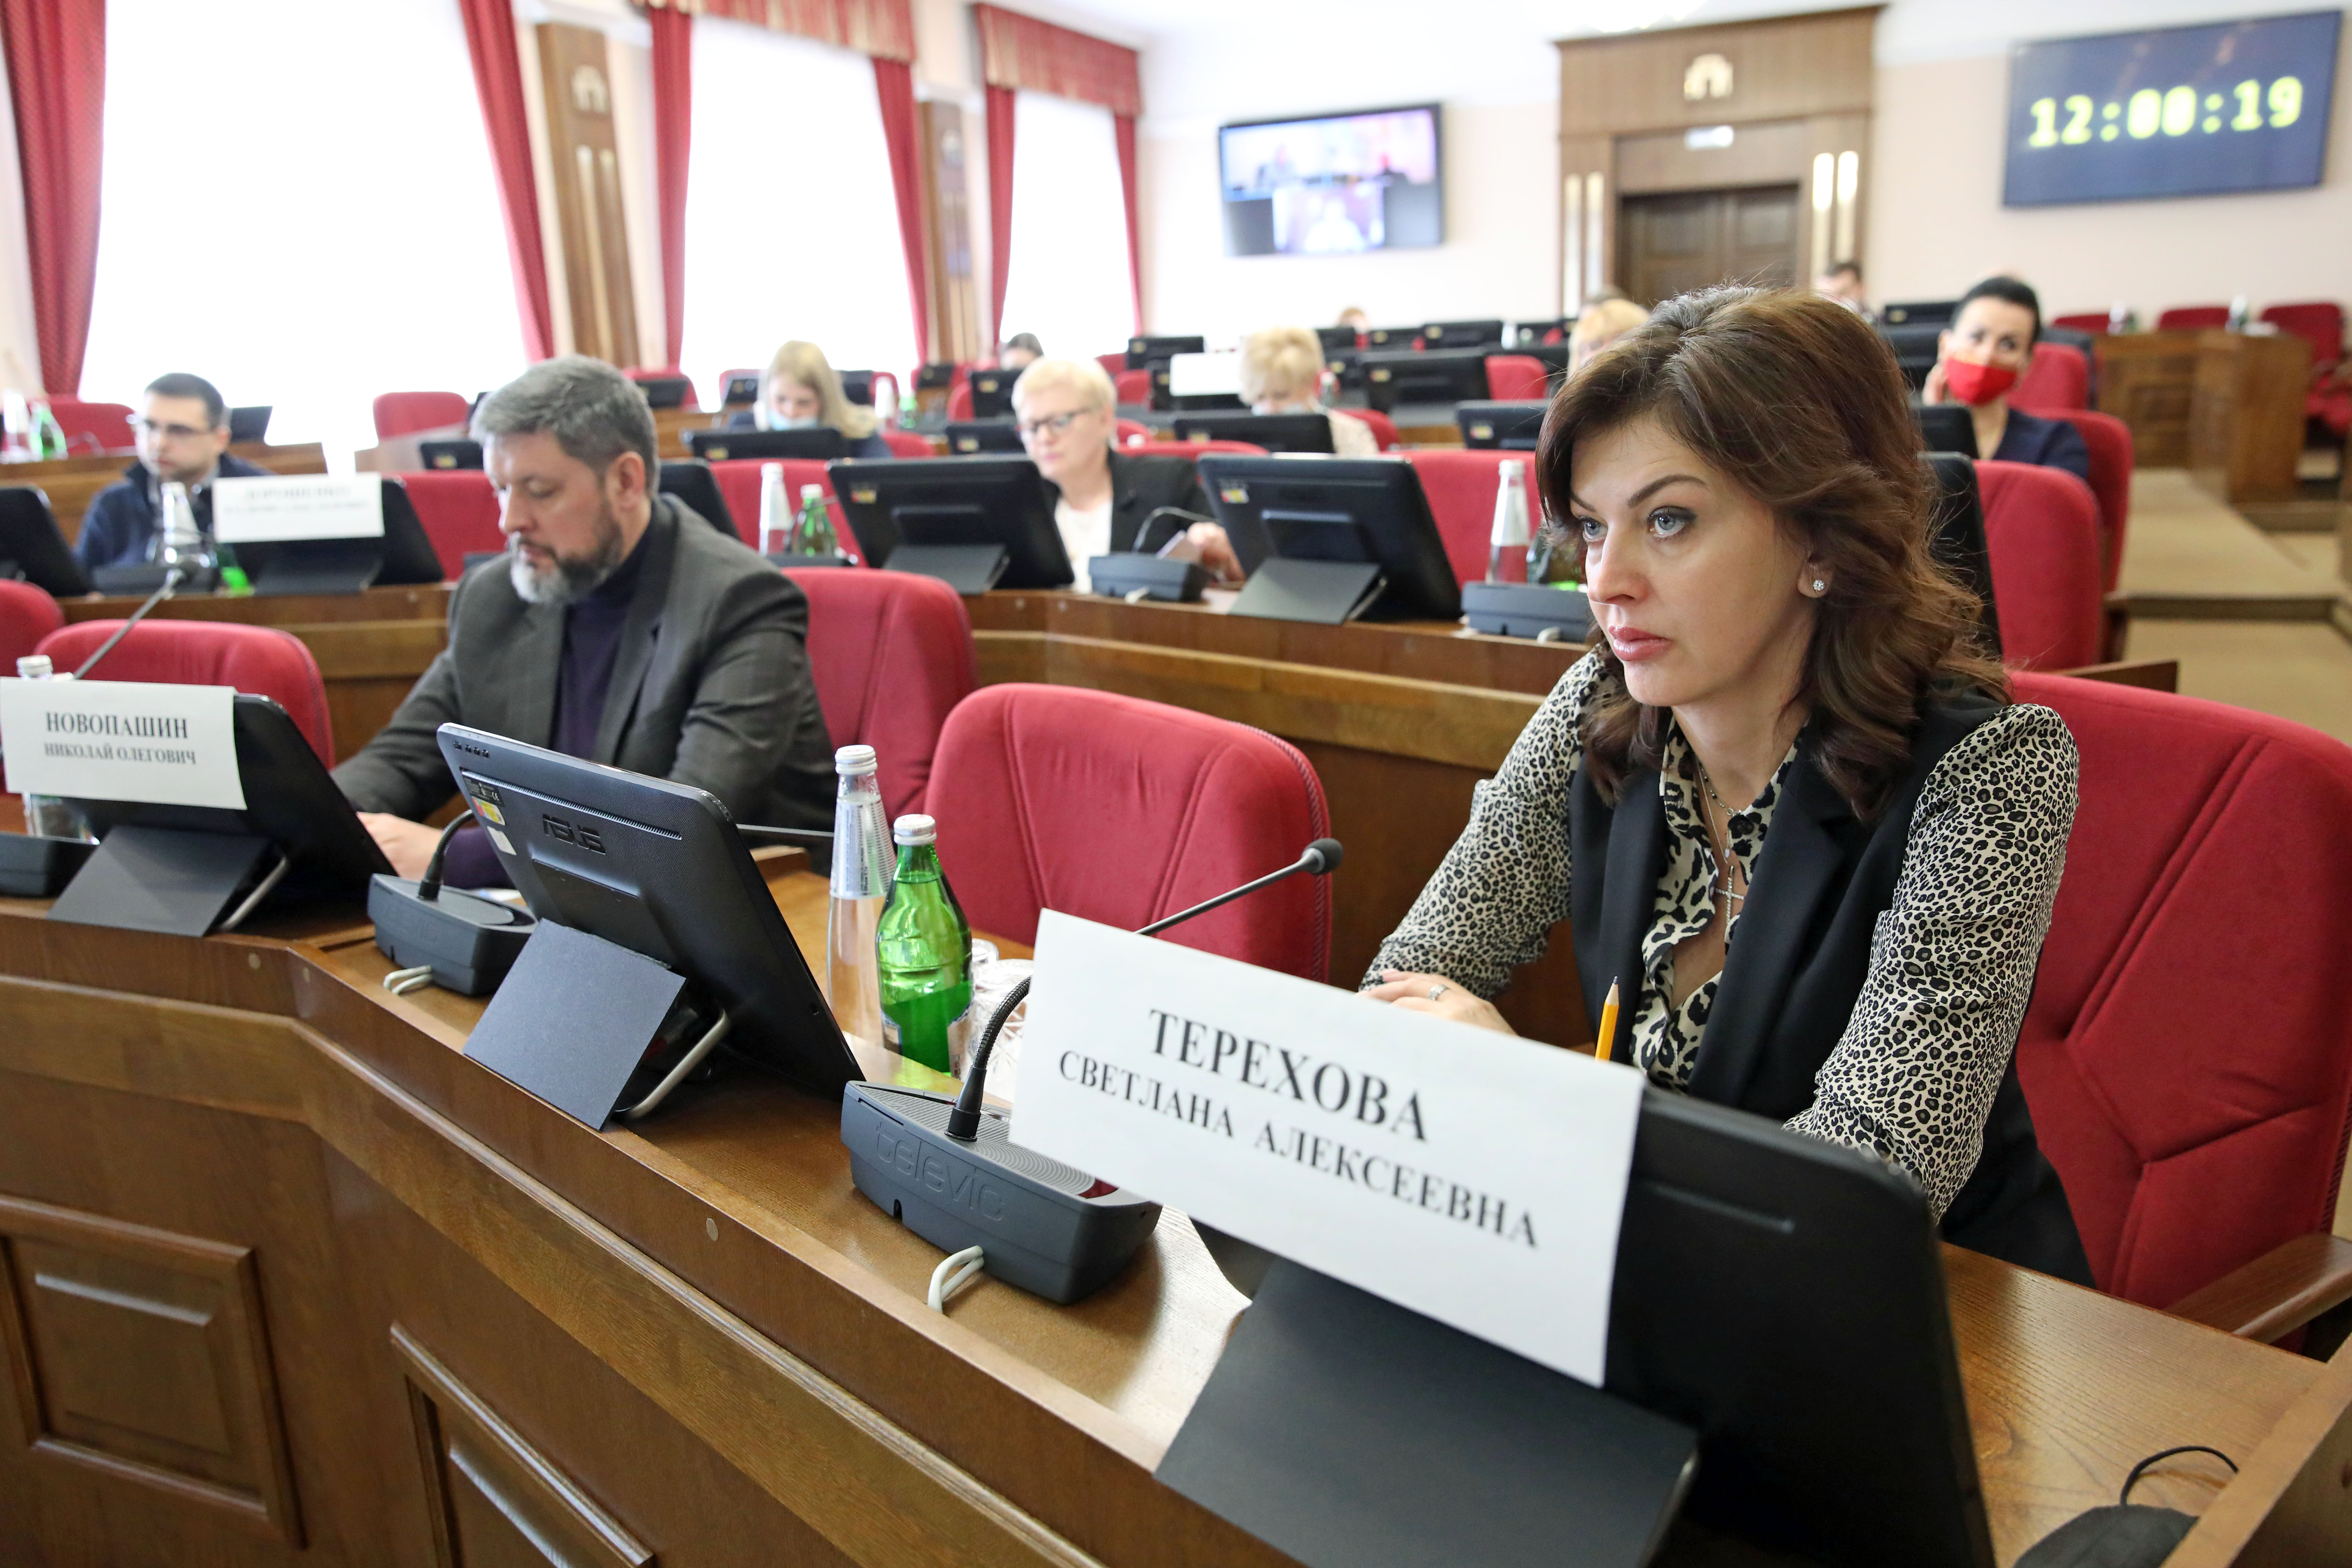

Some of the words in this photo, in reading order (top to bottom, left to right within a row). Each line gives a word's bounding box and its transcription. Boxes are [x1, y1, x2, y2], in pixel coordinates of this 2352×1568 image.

[2028, 75, 2303, 148] 12:00:19
[44, 742, 114, 761] НИКОЛАЙ
[116, 747, 197, 764] ОЛЕГОВИЧ
[46, 712, 189, 739] НОВОПАШИН
[542, 814, 606, 855] ASUS
[1149, 1009, 1427, 1143] ТЕРЕХОВА
[876, 1121, 1004, 1221] televic
[1059, 1050, 1234, 1138] СВЕТЛАНА
[1254, 1121, 1539, 1248] АЛЕКСЕЕВНА
